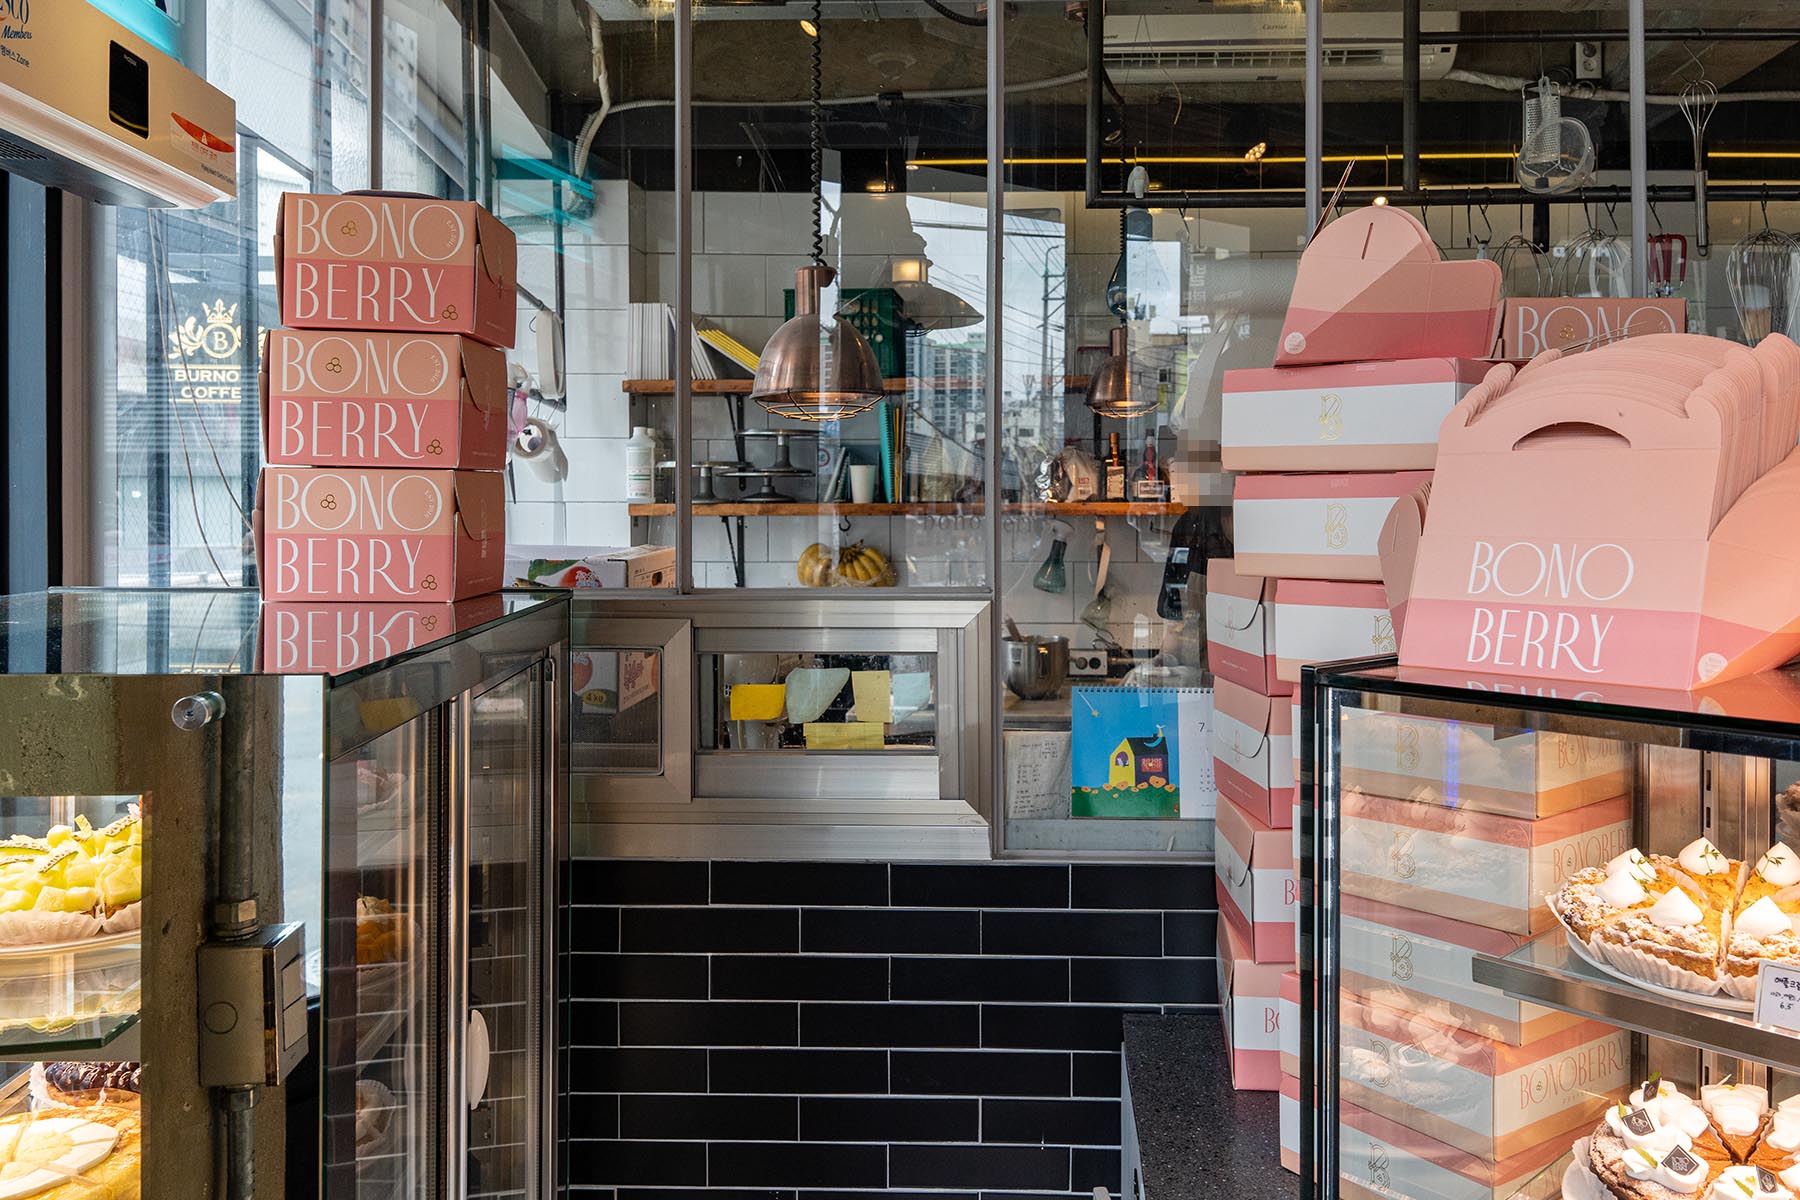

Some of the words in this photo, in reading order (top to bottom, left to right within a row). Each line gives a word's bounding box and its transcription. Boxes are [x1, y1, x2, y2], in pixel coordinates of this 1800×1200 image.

[297, 198, 464, 261] BONO
[295, 262, 445, 325] BERRY
[282, 336, 449, 396] BONO
[280, 400, 429, 460] BERRY
[276, 473, 443, 532] BONO
[276, 538, 423, 595] BERRY
[1467, 541, 1635, 601] BONO
[1466, 607, 1614, 674] BERRY
[1198, 722, 1206, 732] 7
